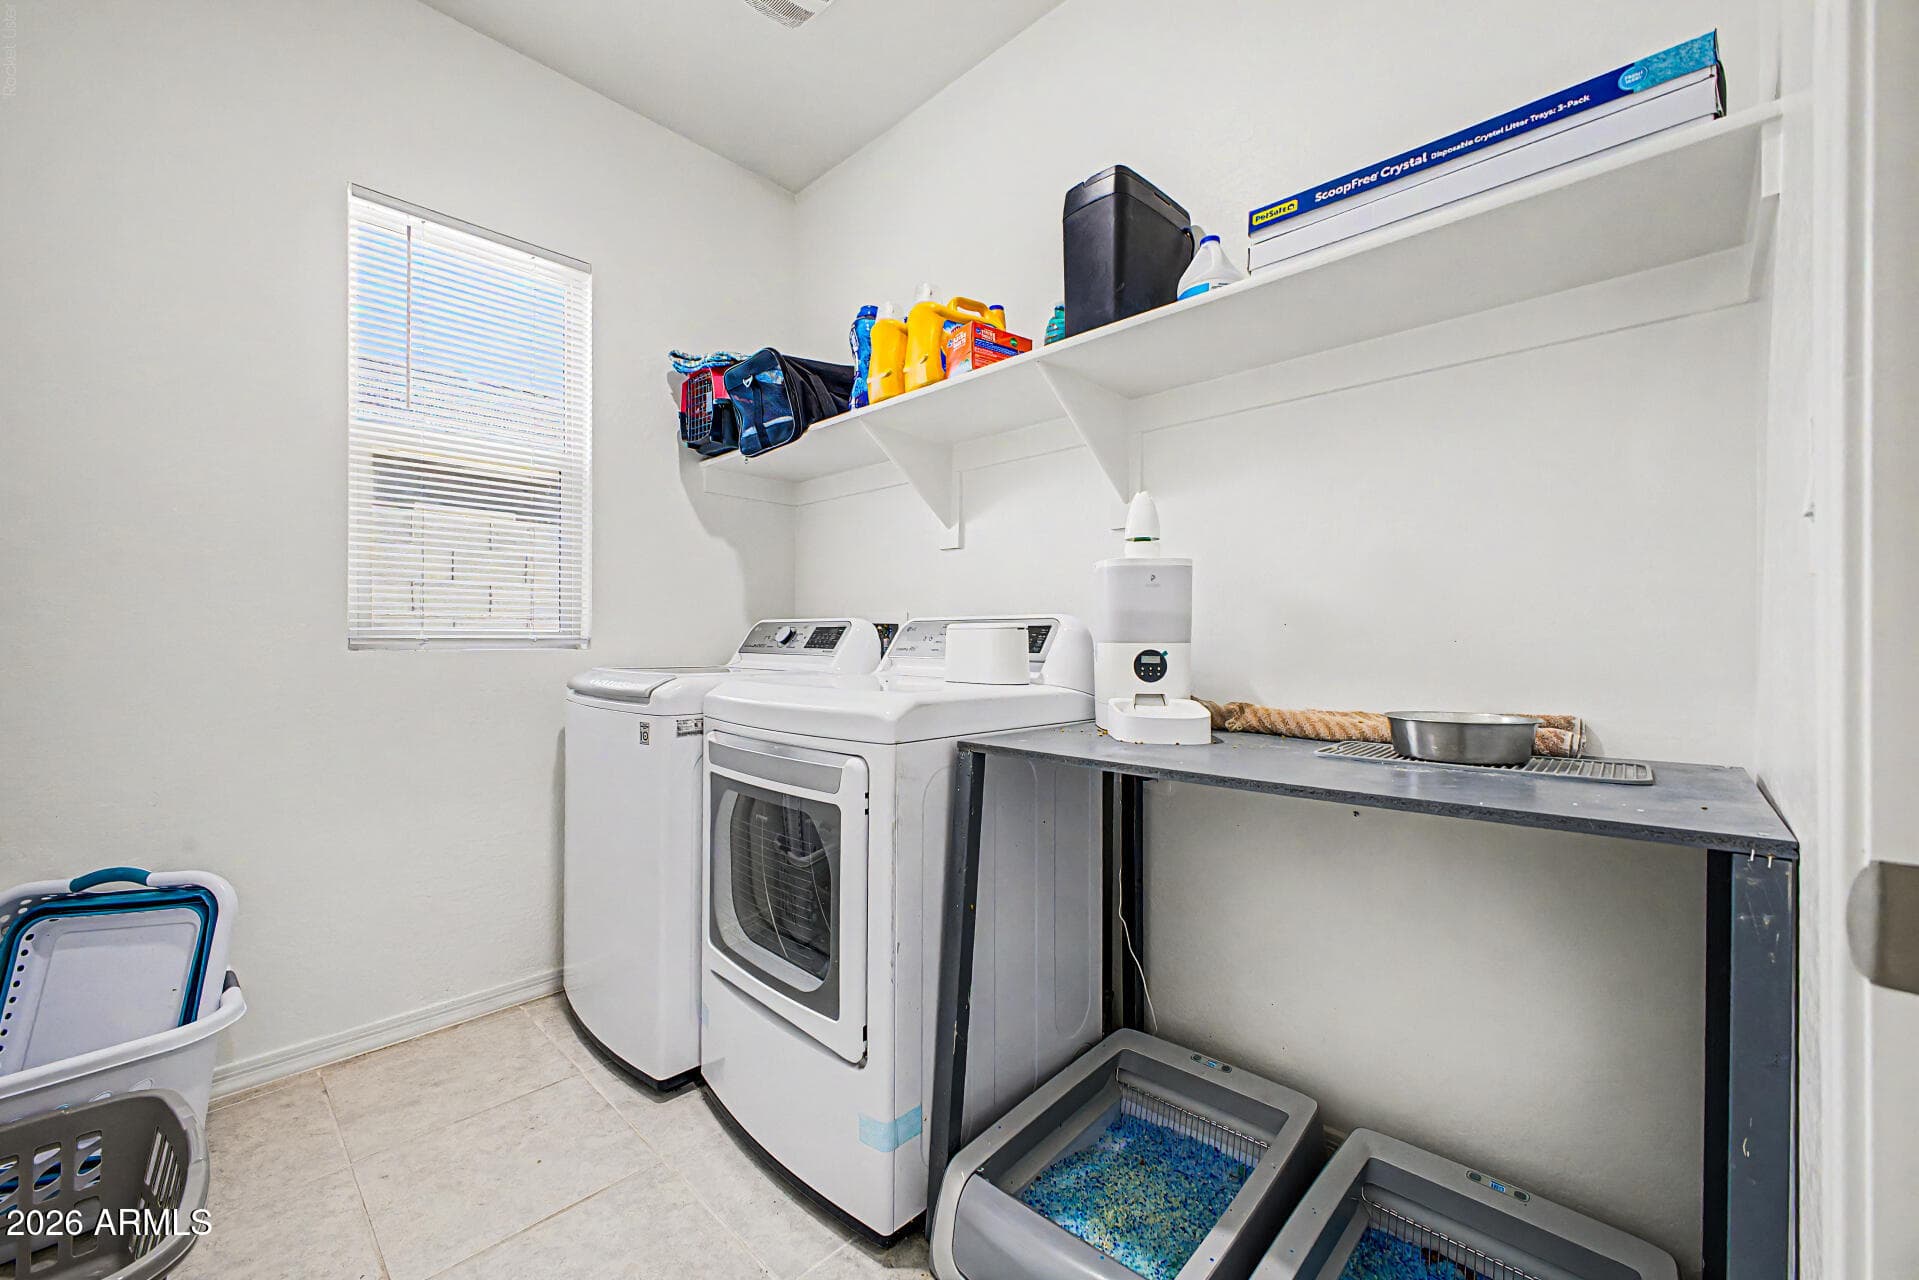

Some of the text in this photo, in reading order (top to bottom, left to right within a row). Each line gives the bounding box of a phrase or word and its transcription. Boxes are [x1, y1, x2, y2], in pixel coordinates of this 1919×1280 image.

[1430, 138, 1474, 160] Disposable
[1474, 127, 1504, 144] Crystal
[1505, 117, 1529, 132] Litter
[1557, 94, 1591, 112] 3-Pack
[1314, 151, 1428, 203] ScoopFree Crystal
[1255, 205, 1288, 223] PetSafe
